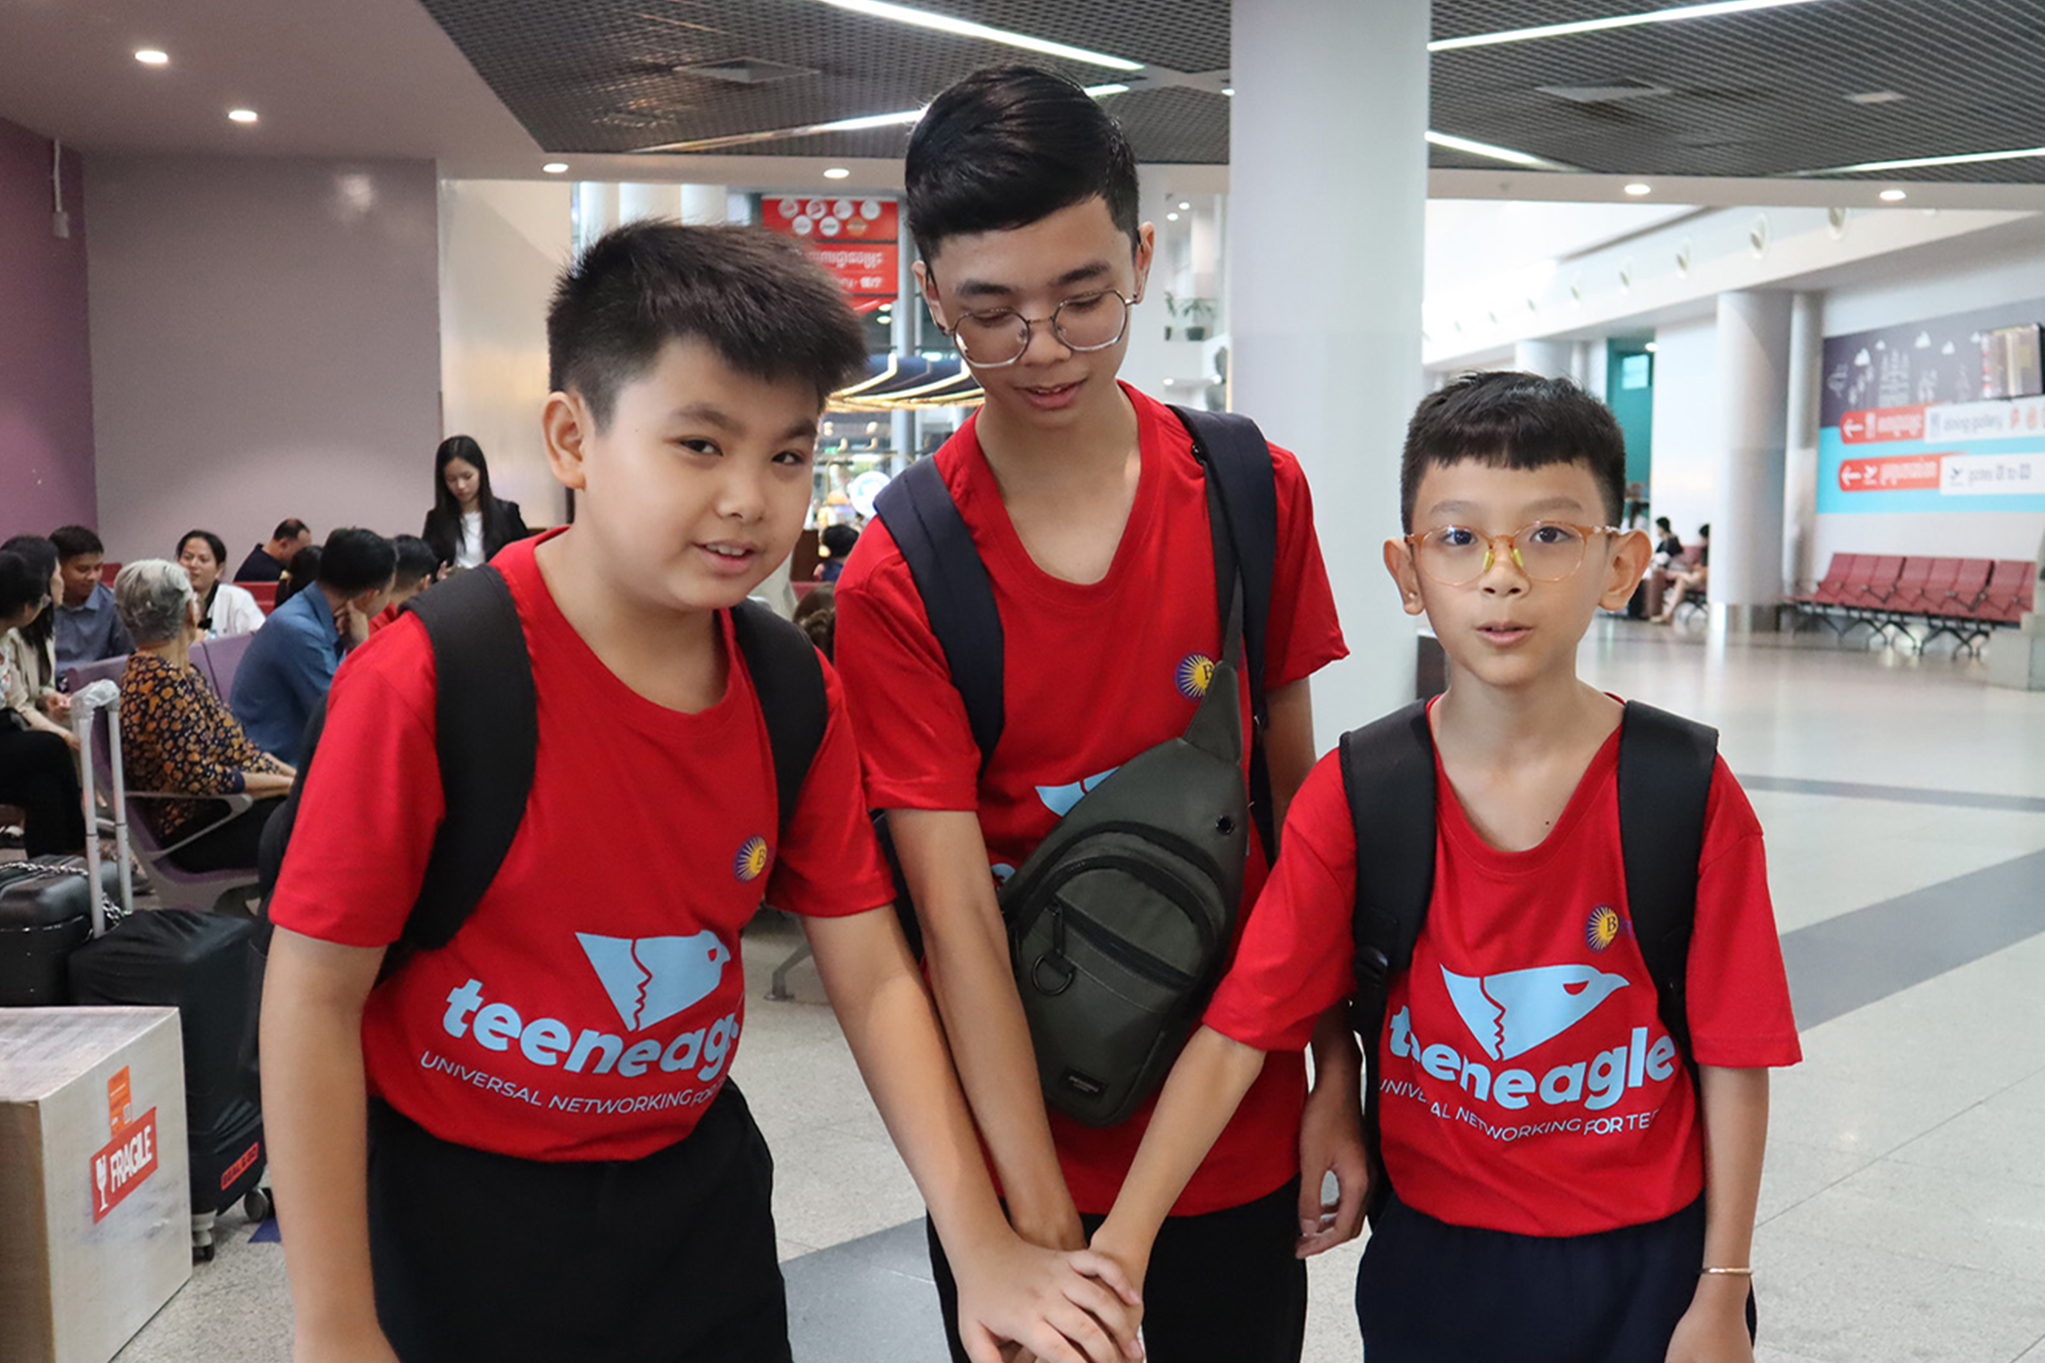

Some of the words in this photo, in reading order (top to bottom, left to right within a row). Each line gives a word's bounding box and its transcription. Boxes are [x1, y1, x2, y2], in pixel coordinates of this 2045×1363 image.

[443, 978, 740, 1081] teeneag
[420, 1050, 542, 1106] UNIVERSAL
[548, 1088, 693, 1114] NETWORKING
[1455, 1106, 1582, 1142] NETWORKING
[1583, 1116, 1623, 1136] FOR
[110, 1125, 153, 1193] FRAGILE
